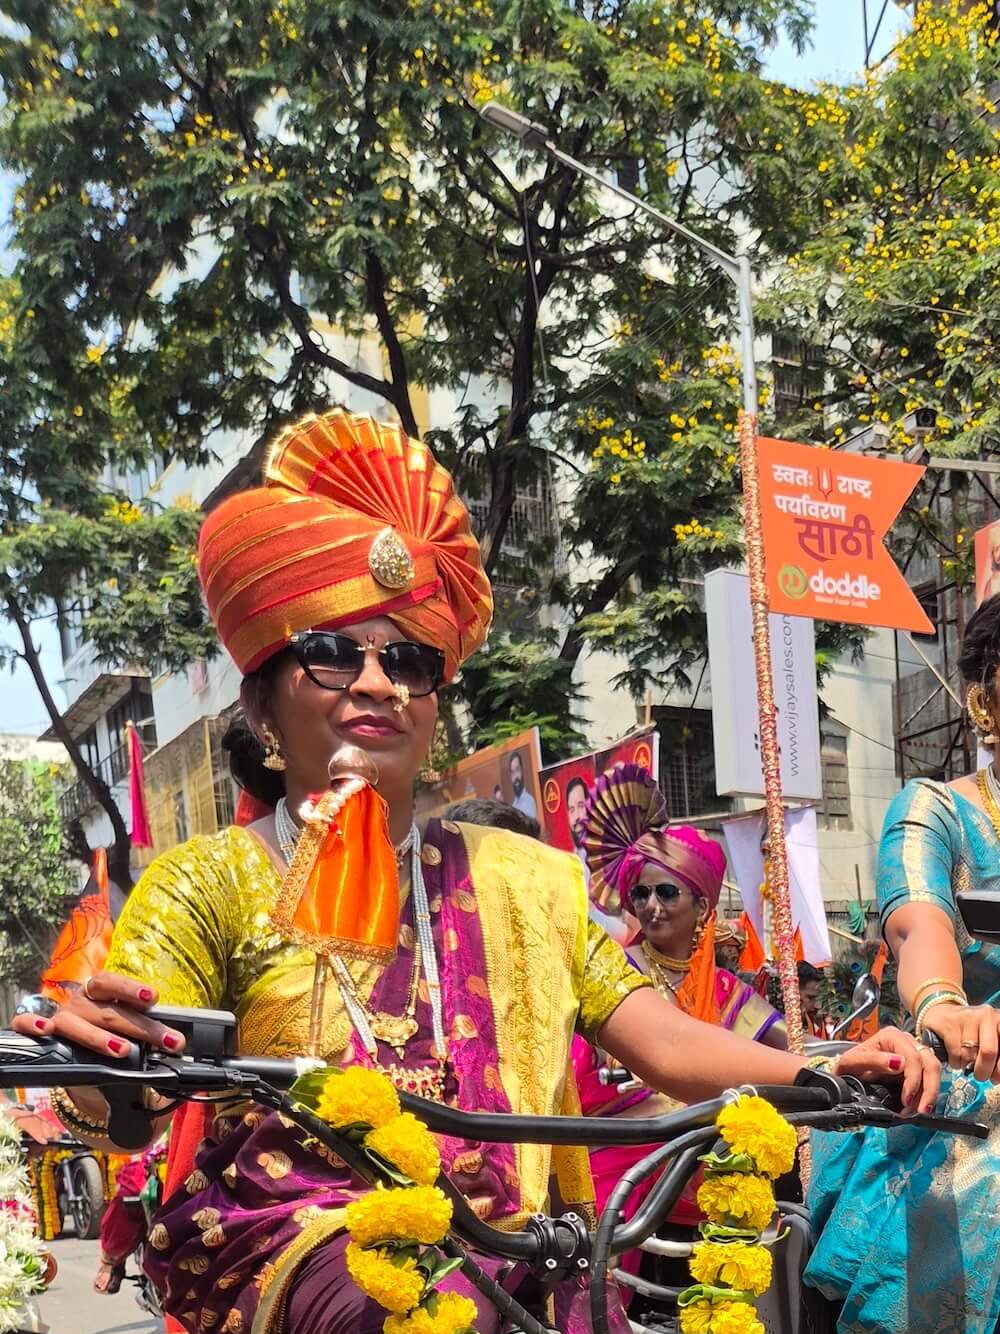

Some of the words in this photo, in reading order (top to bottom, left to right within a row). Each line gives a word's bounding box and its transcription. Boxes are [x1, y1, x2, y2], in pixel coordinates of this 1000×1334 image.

[771, 464, 814, 487] स्वतः
[836, 475, 872, 500] राष्ट्र
[773, 494, 847, 523] पर्यावरण
[793, 514, 875, 563] साठी
[809, 569, 881, 601] doddle
